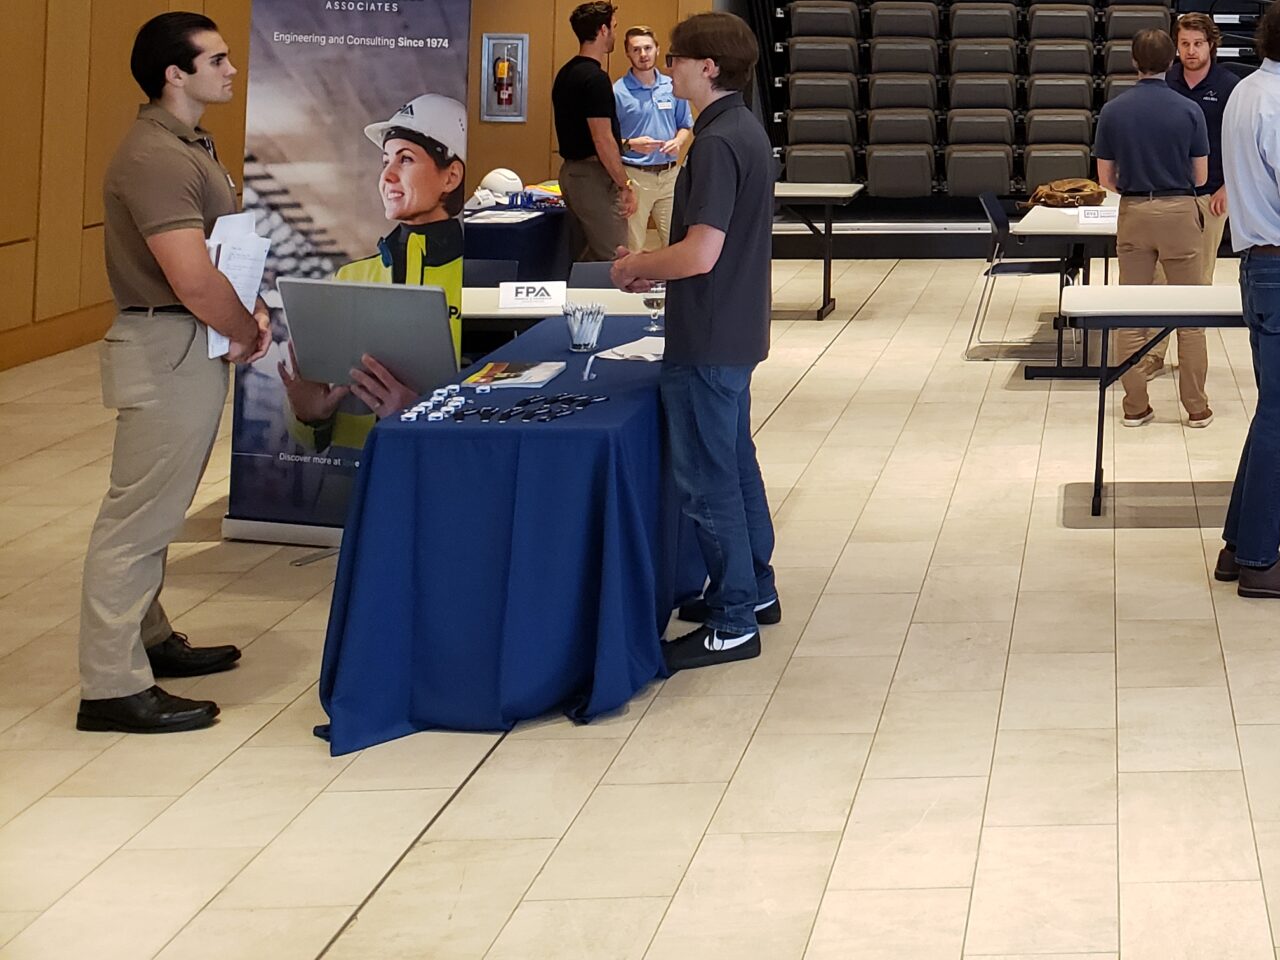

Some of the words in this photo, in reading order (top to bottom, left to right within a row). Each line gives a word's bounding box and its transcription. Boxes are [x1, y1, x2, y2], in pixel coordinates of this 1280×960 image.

[325, 1, 398, 12] ASSOCIATES
[273, 31, 326, 46] Engineering
[328, 35, 344, 44] and
[346, 35, 396, 48] Consulting
[397, 36, 424, 47] Since
[426, 38, 449, 48] 1974
[514, 286, 551, 297] FPA
[279, 452, 311, 463] Discover
[312, 456, 331, 465] more
[333, 458, 341, 466] at
